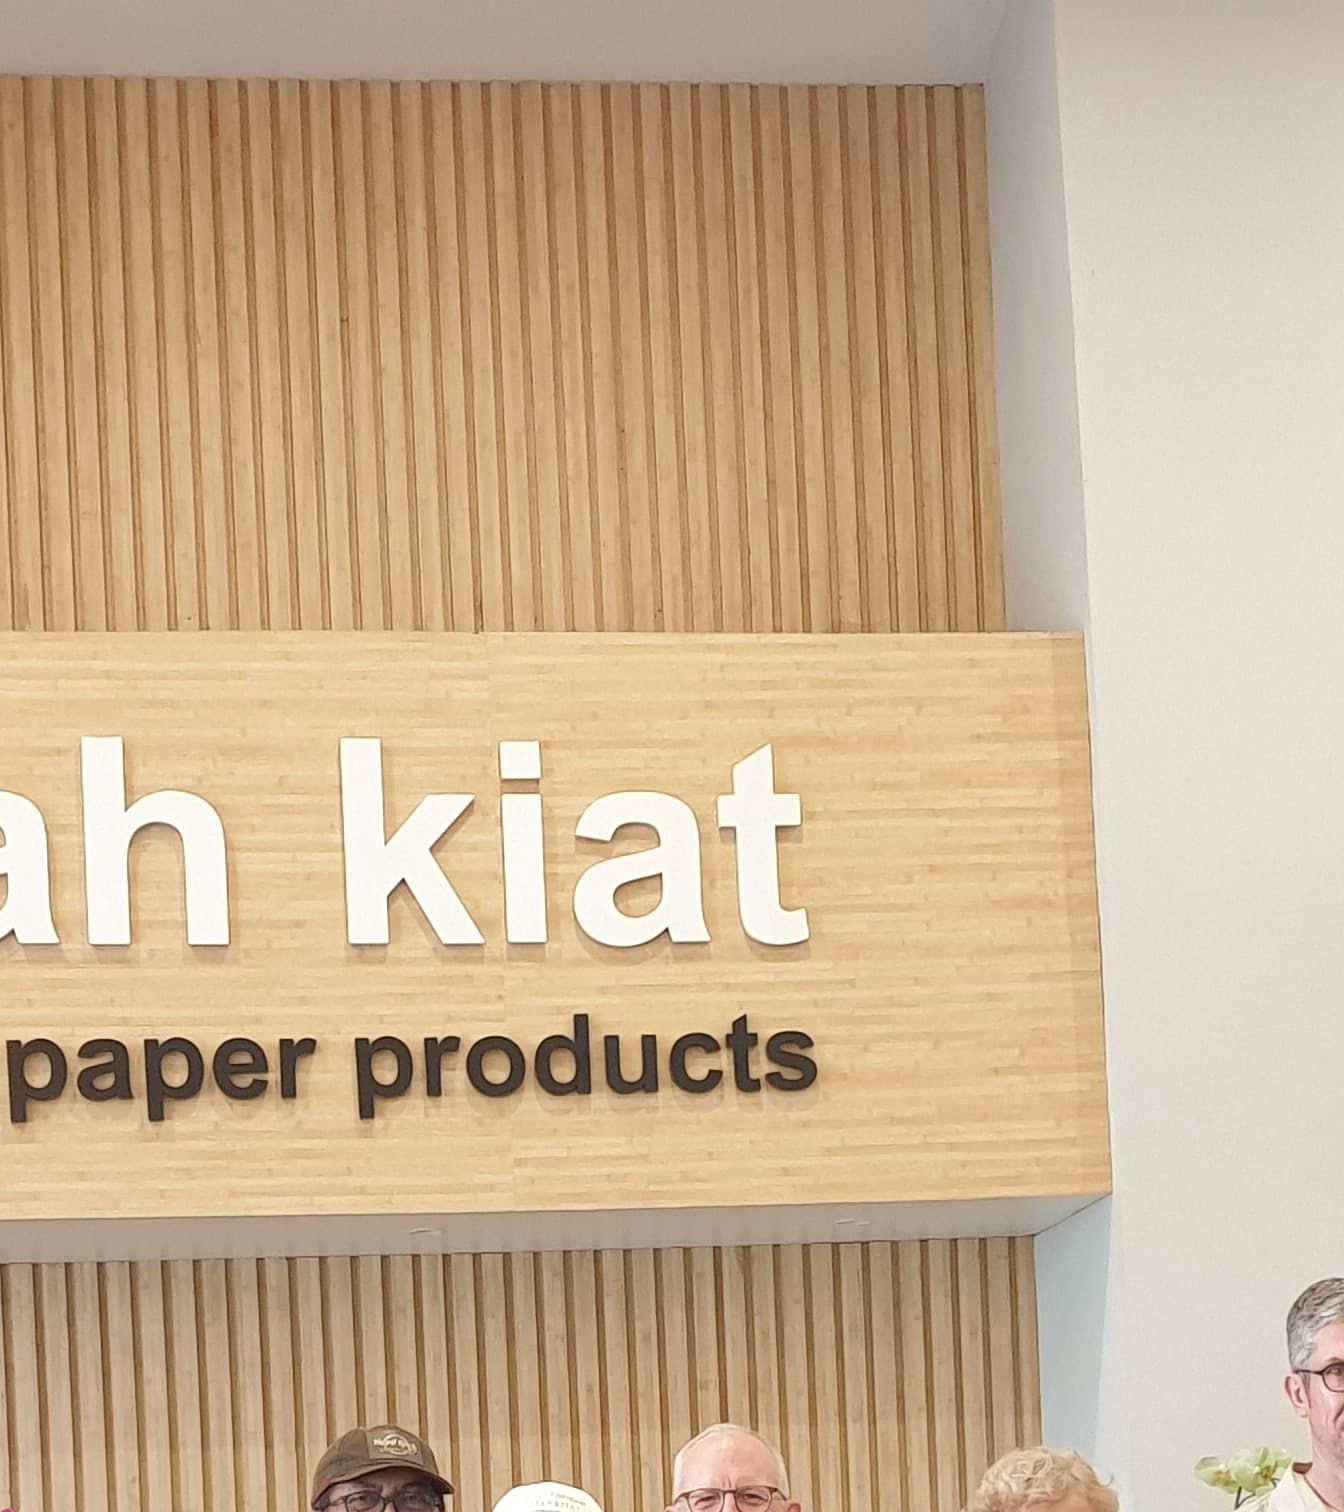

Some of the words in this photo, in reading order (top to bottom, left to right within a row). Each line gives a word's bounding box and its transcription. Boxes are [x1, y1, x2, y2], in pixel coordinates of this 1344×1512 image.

[339, 736, 812, 950] kiat
[8, 1023, 316, 1122] paper
[356, 1013, 819, 1118] products
